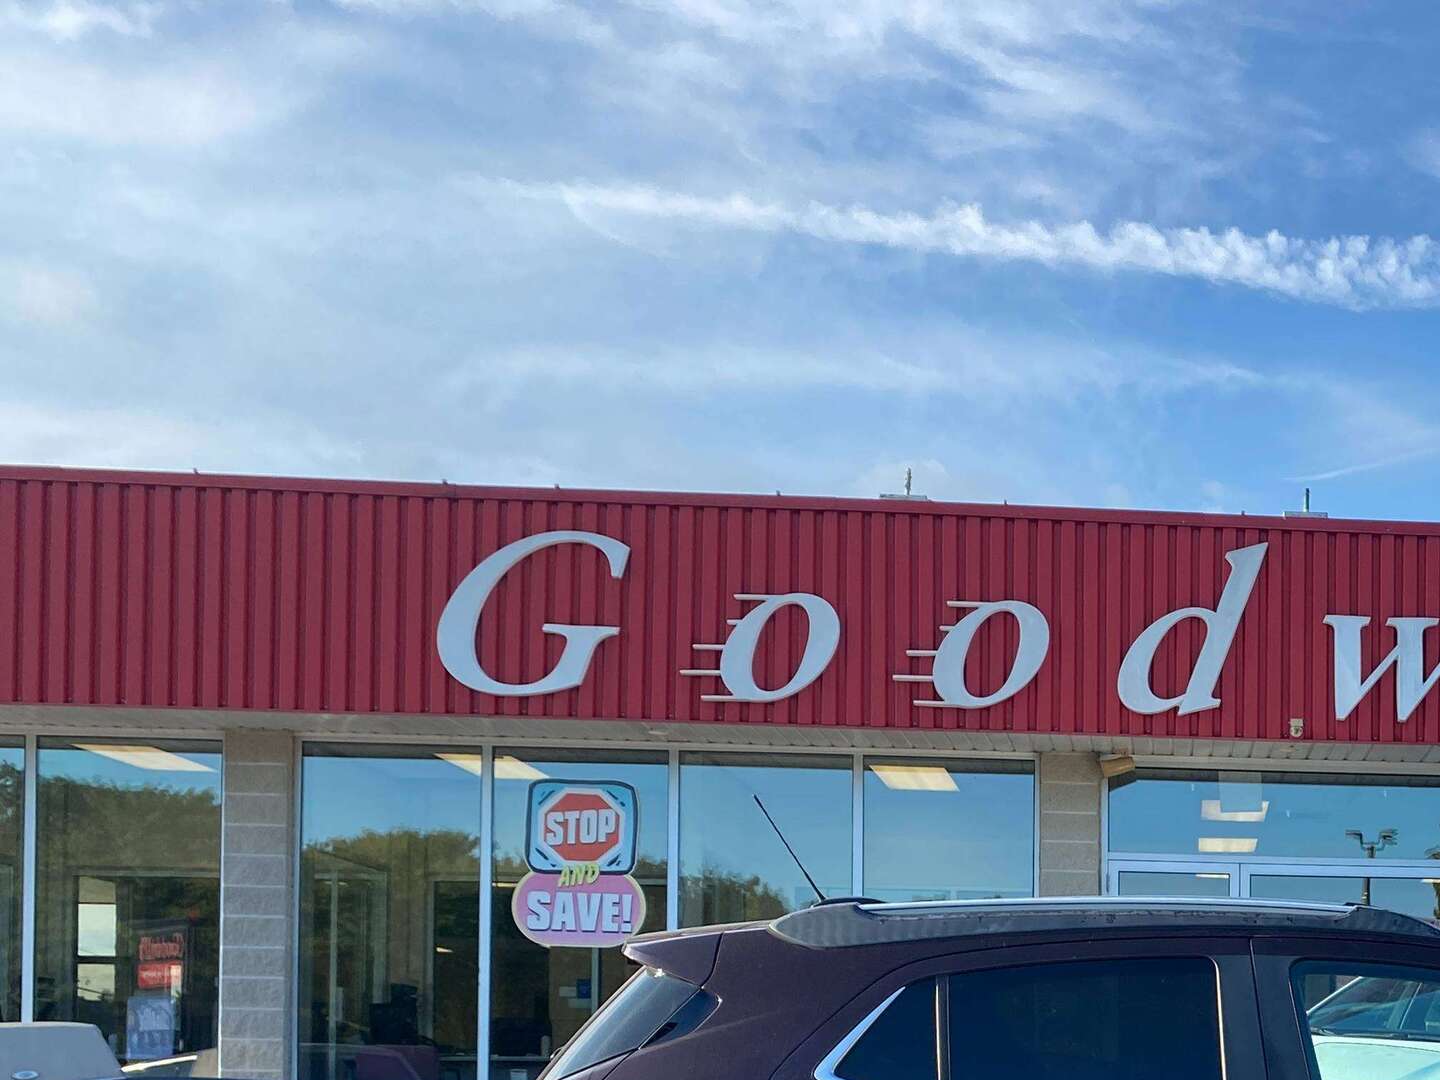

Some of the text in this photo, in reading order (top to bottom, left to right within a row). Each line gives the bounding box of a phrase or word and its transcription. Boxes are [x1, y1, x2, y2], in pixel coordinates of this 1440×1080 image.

[546, 808, 616, 846] STOP
[557, 862, 600, 888] AND
[527, 890, 633, 934] SAVE!
